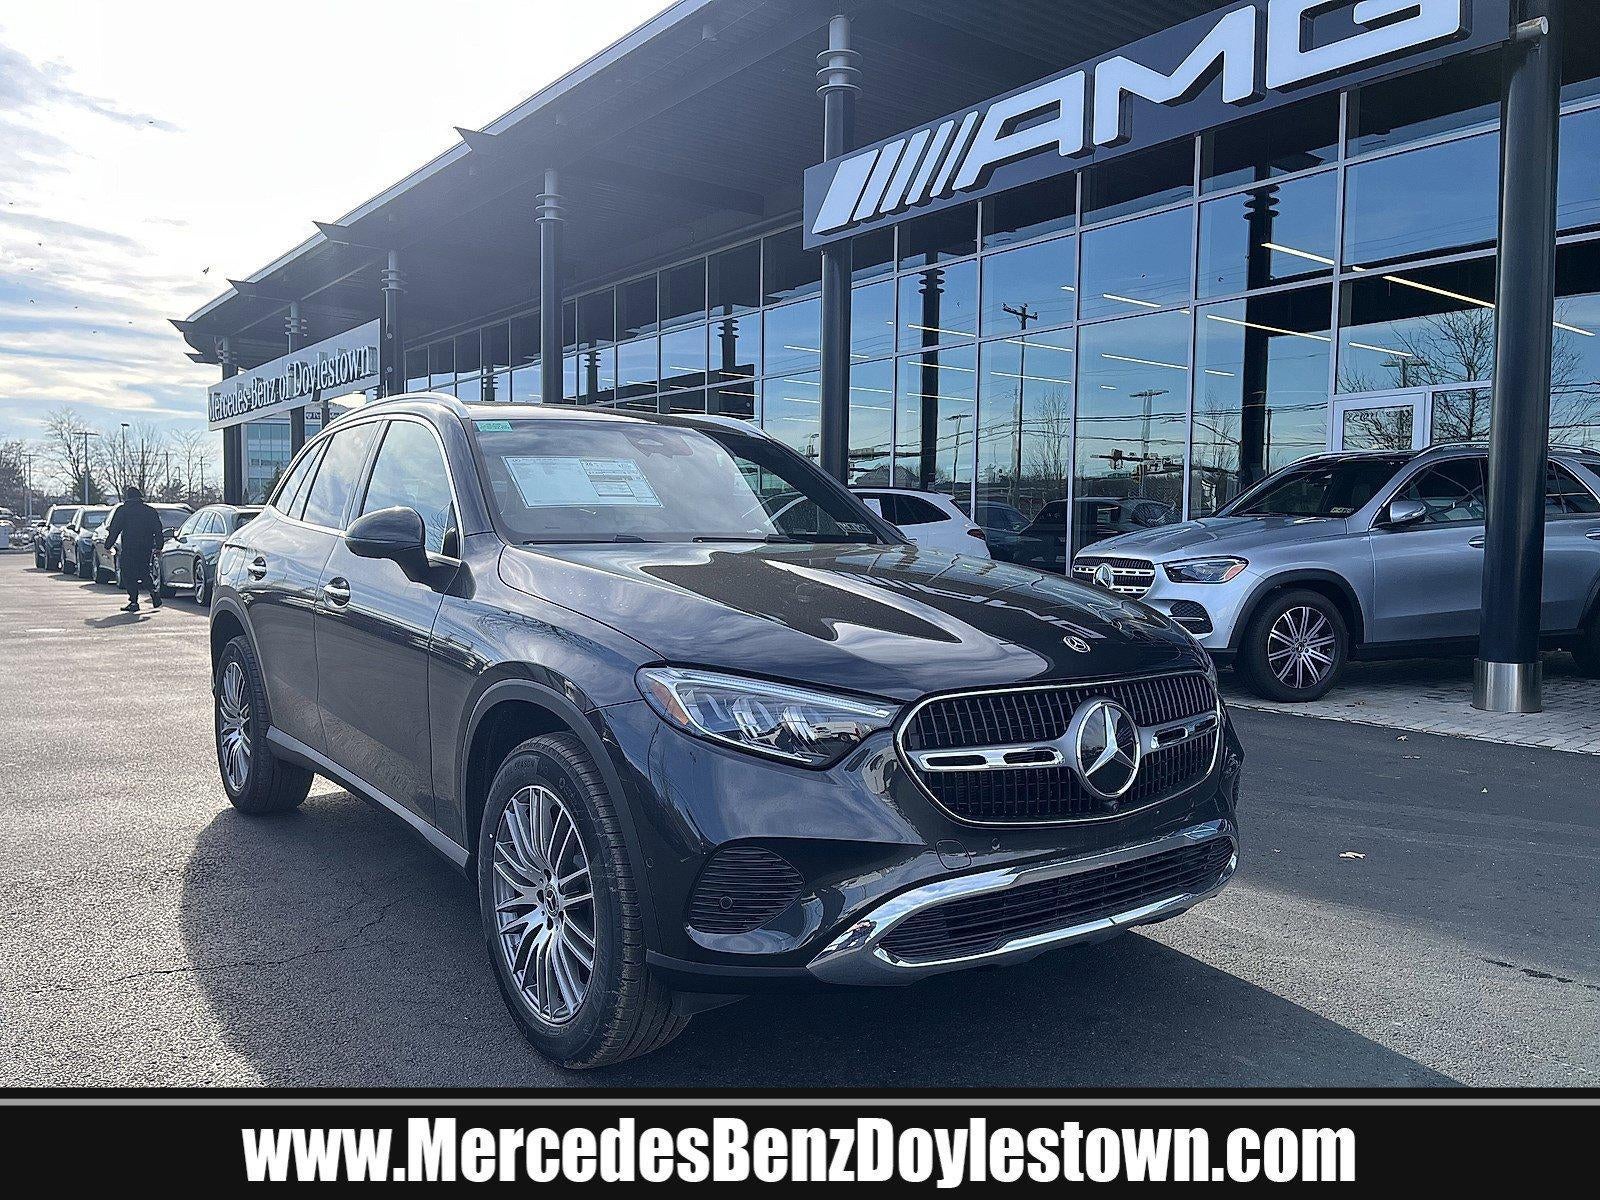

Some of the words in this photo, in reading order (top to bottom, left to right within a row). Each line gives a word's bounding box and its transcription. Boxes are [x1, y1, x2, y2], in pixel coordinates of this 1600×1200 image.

[952, 0, 1461, 191] AMG
[209, 376, 277, 421] Mercedes-Benz
[279, 363, 293, 400] of
[294, 346, 373, 401] Doylestown
